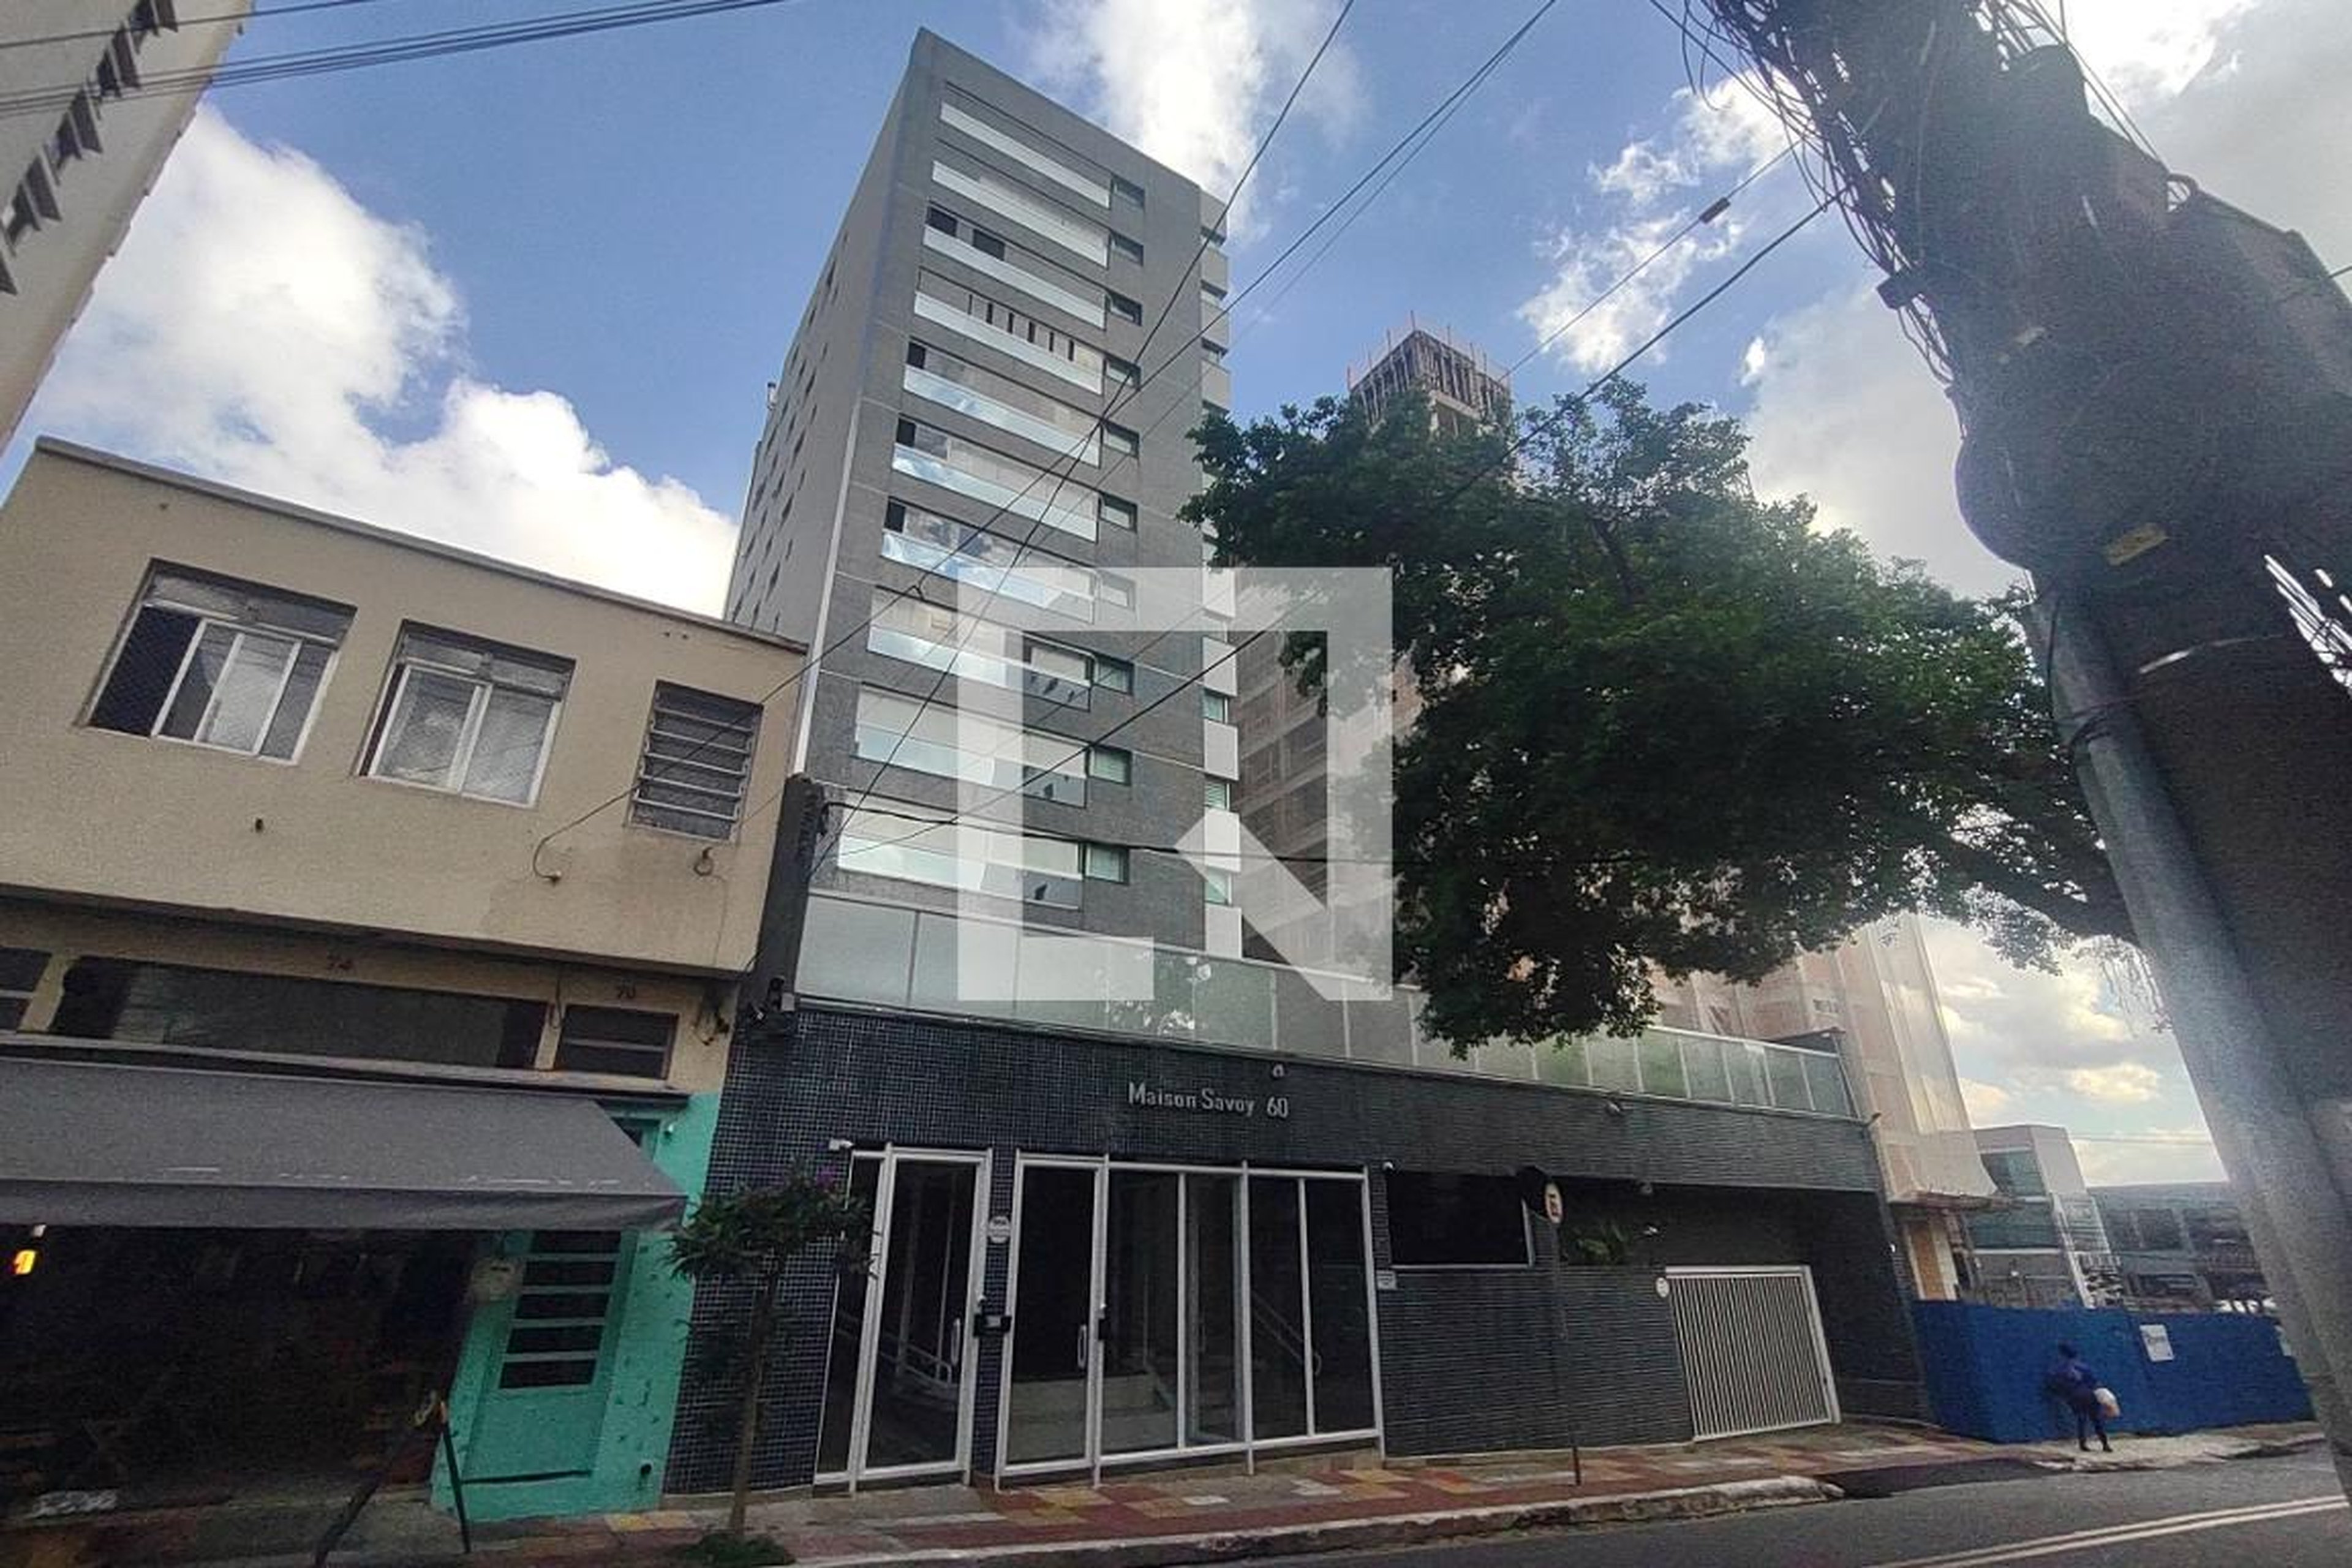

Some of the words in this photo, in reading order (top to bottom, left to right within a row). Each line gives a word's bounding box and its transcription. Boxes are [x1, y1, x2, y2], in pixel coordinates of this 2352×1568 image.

[1128, 1081, 1196, 1109] Maison
[1200, 1087, 1255, 1117] Savoy
[1266, 1096, 1288, 1118] 60
